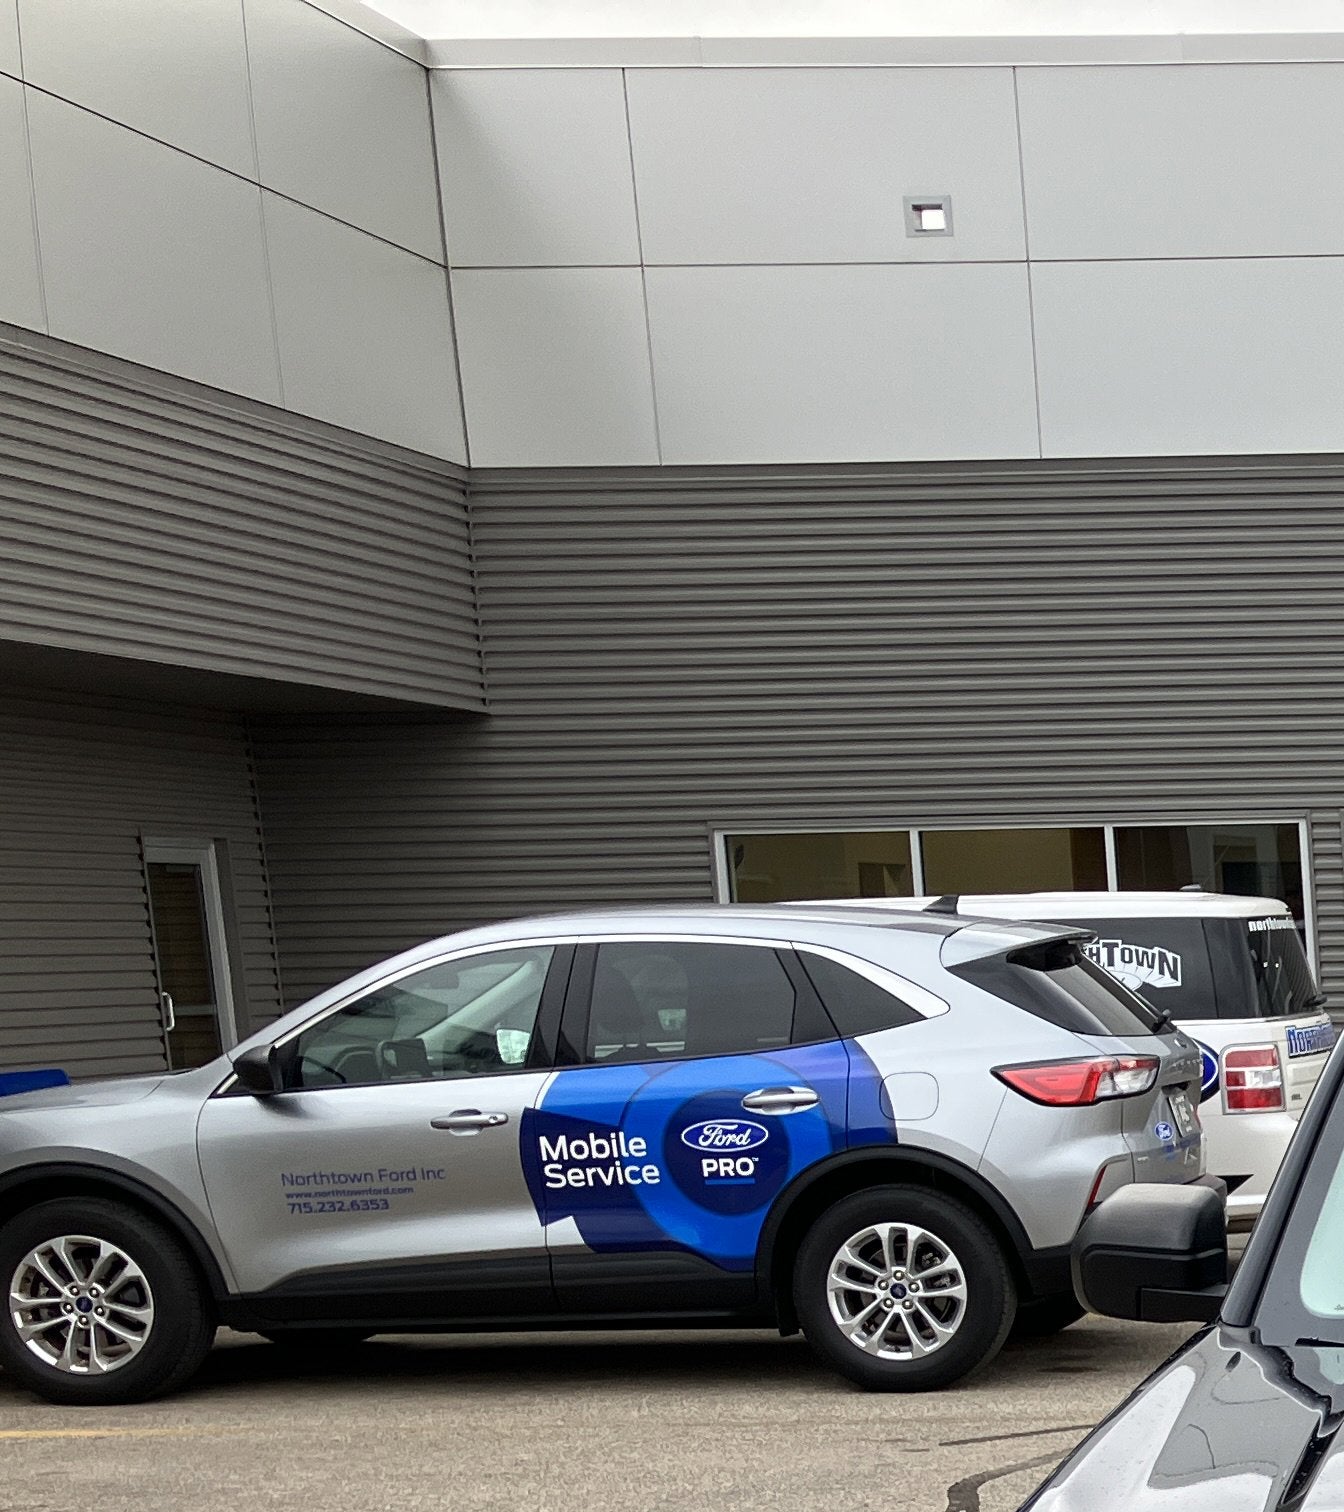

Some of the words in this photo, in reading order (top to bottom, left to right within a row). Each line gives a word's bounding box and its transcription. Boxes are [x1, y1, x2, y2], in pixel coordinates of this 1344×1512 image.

[1084, 941, 1180, 982] HTOWN
[538, 1132, 647, 1161] Mobile
[698, 1124, 752, 1146] Ford
[281, 1171, 374, 1187] Northtown
[377, 1167, 417, 1182] Ford
[421, 1167, 446, 1181] Inc
[543, 1161, 660, 1189] Service
[287, 1199, 391, 1215] 715.232.6353
